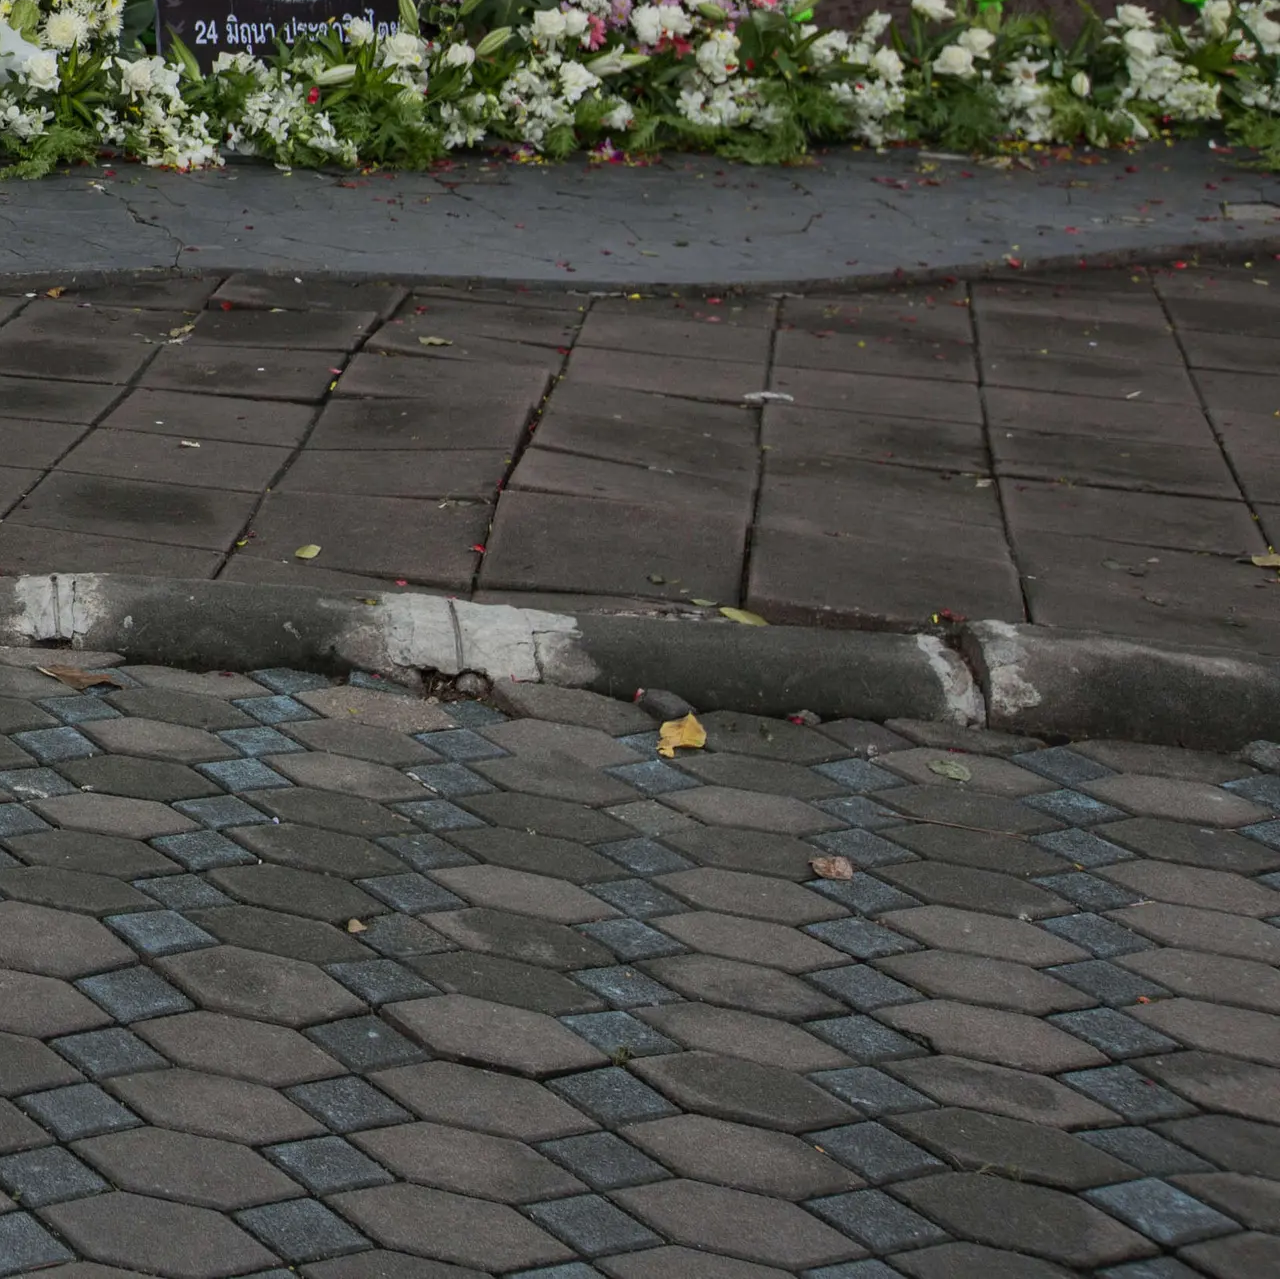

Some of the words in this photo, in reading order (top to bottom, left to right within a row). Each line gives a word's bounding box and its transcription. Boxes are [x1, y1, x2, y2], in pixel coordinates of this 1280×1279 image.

[194, 19, 219, 45] 24
[225, 12, 276, 55] มิถุนา
